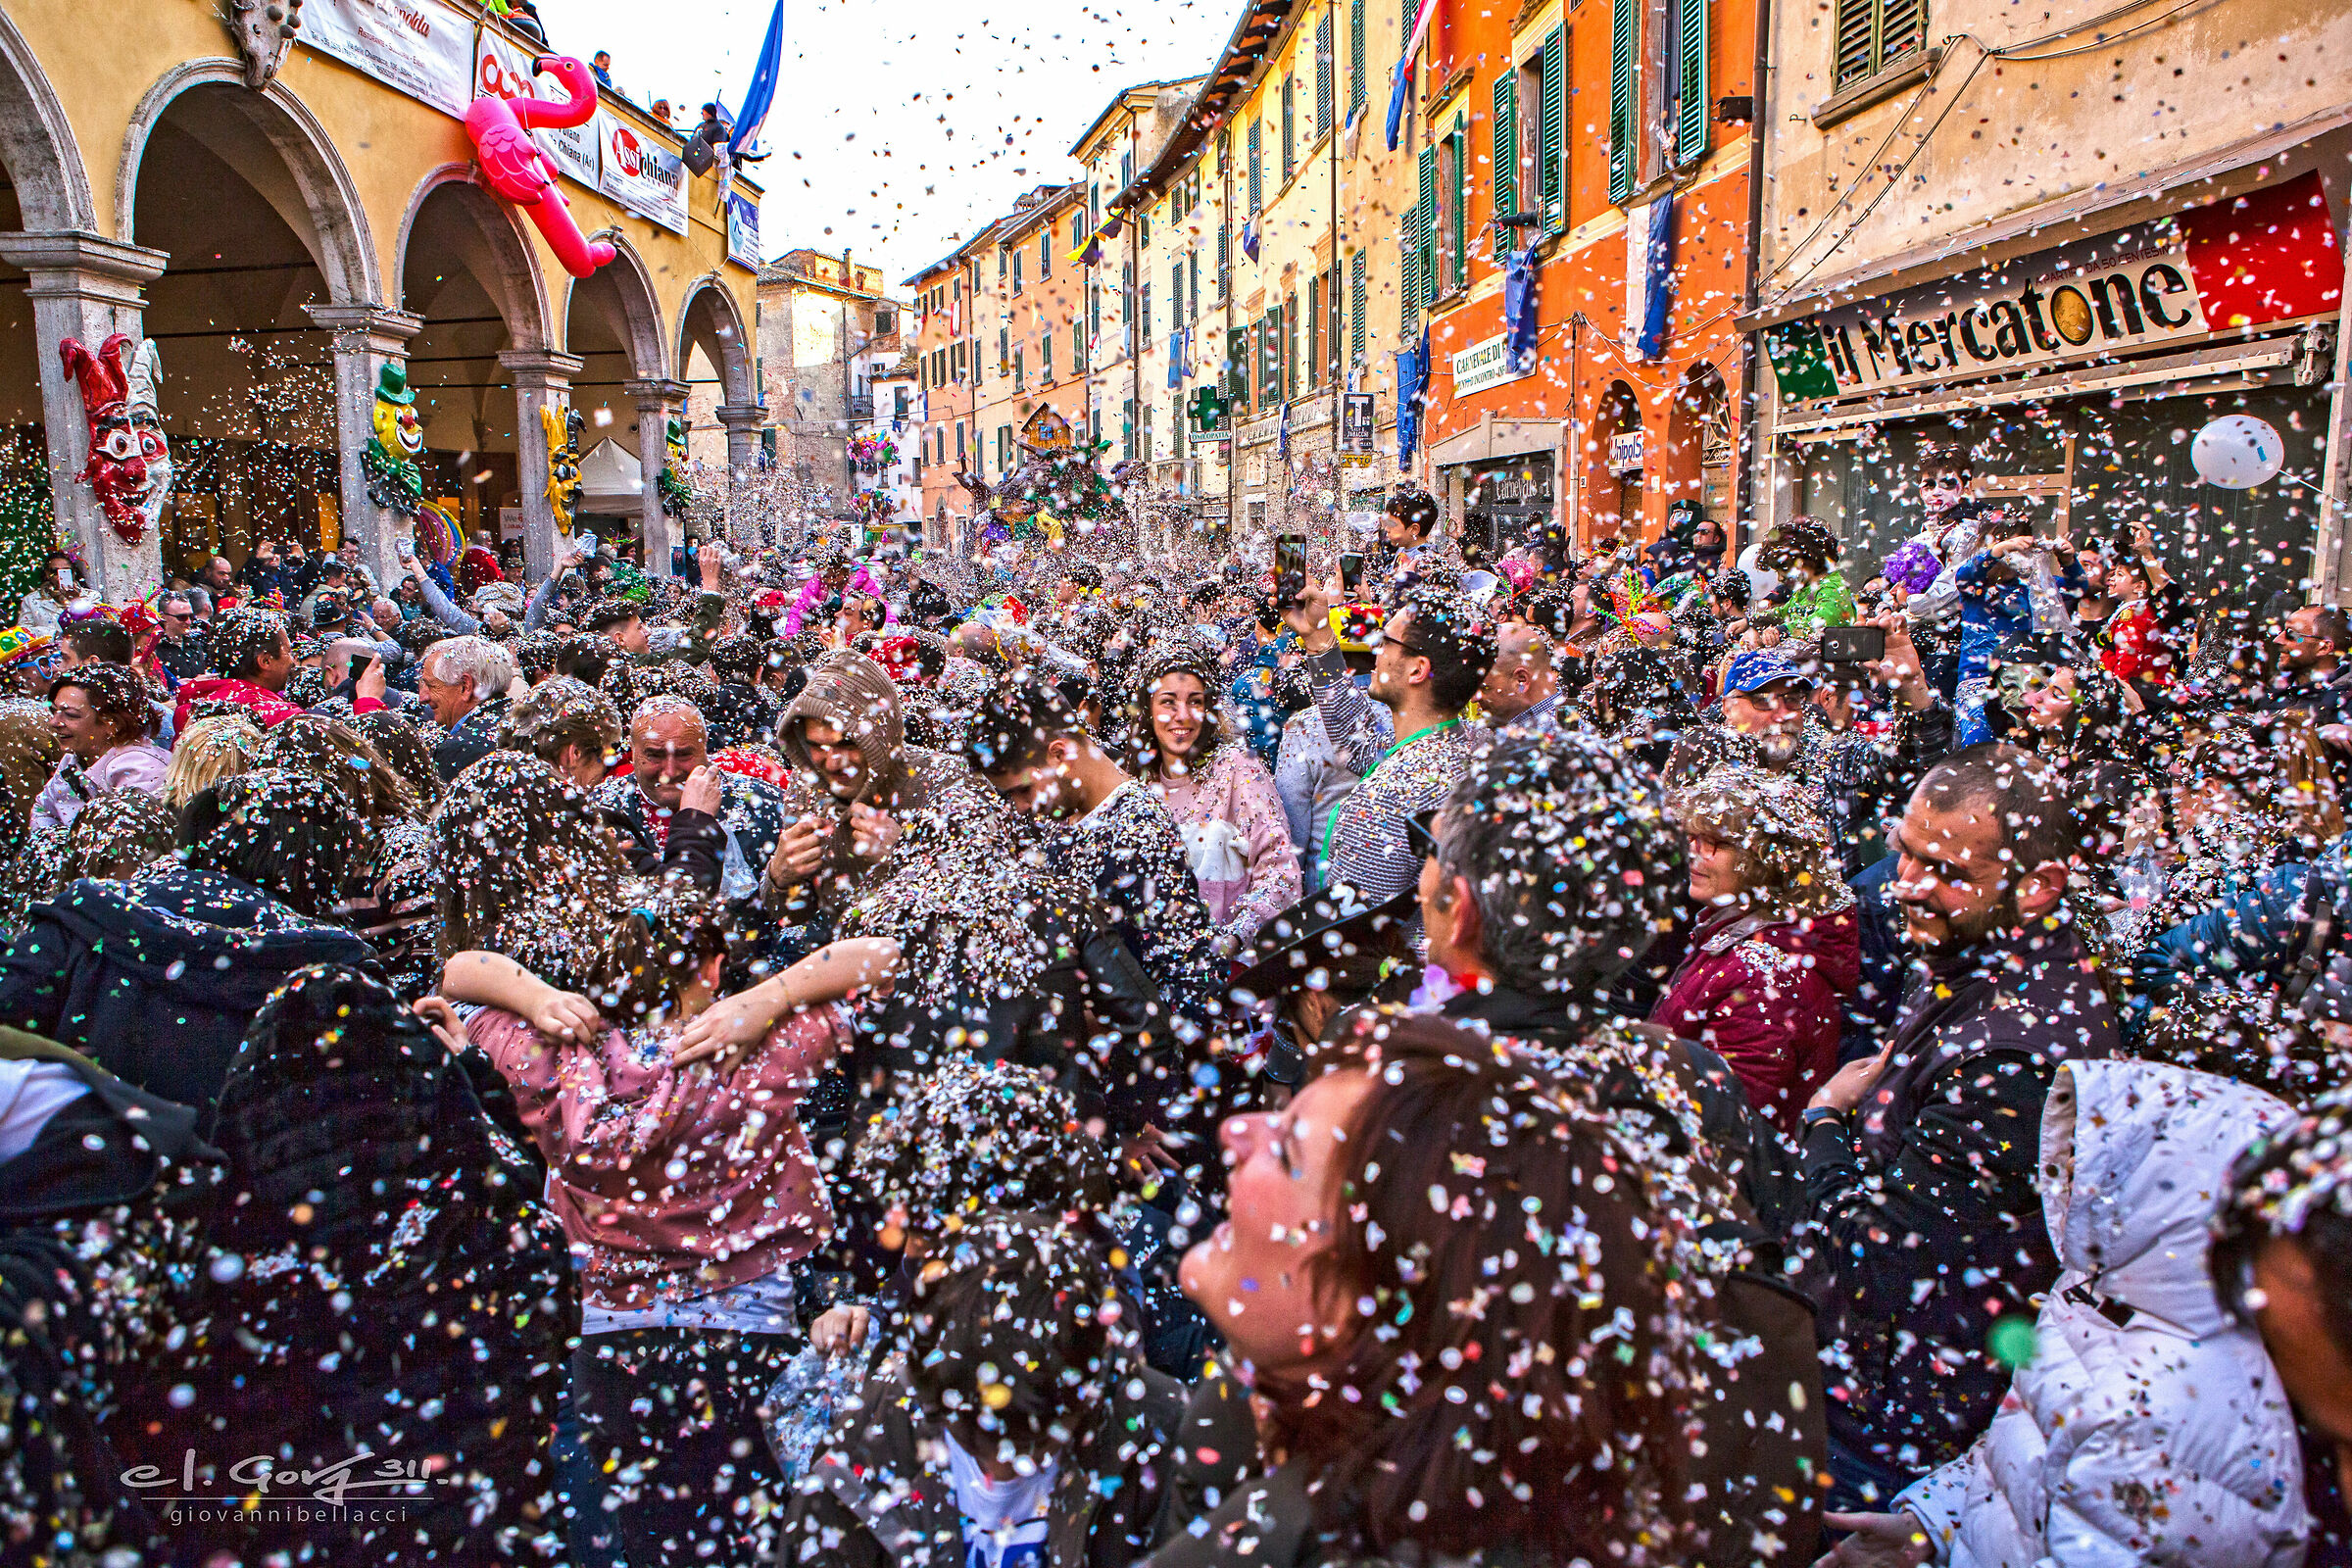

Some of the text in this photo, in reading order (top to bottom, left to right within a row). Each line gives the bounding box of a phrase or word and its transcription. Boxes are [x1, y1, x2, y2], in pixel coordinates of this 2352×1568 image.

[559, 139, 581, 163] Chiana
[2084, 262, 2101, 274] DA
[2101, 257, 2117, 270] 50
[1823, 263, 2193, 386] il Mercatone
[1492, 342, 1500, 361] DI
